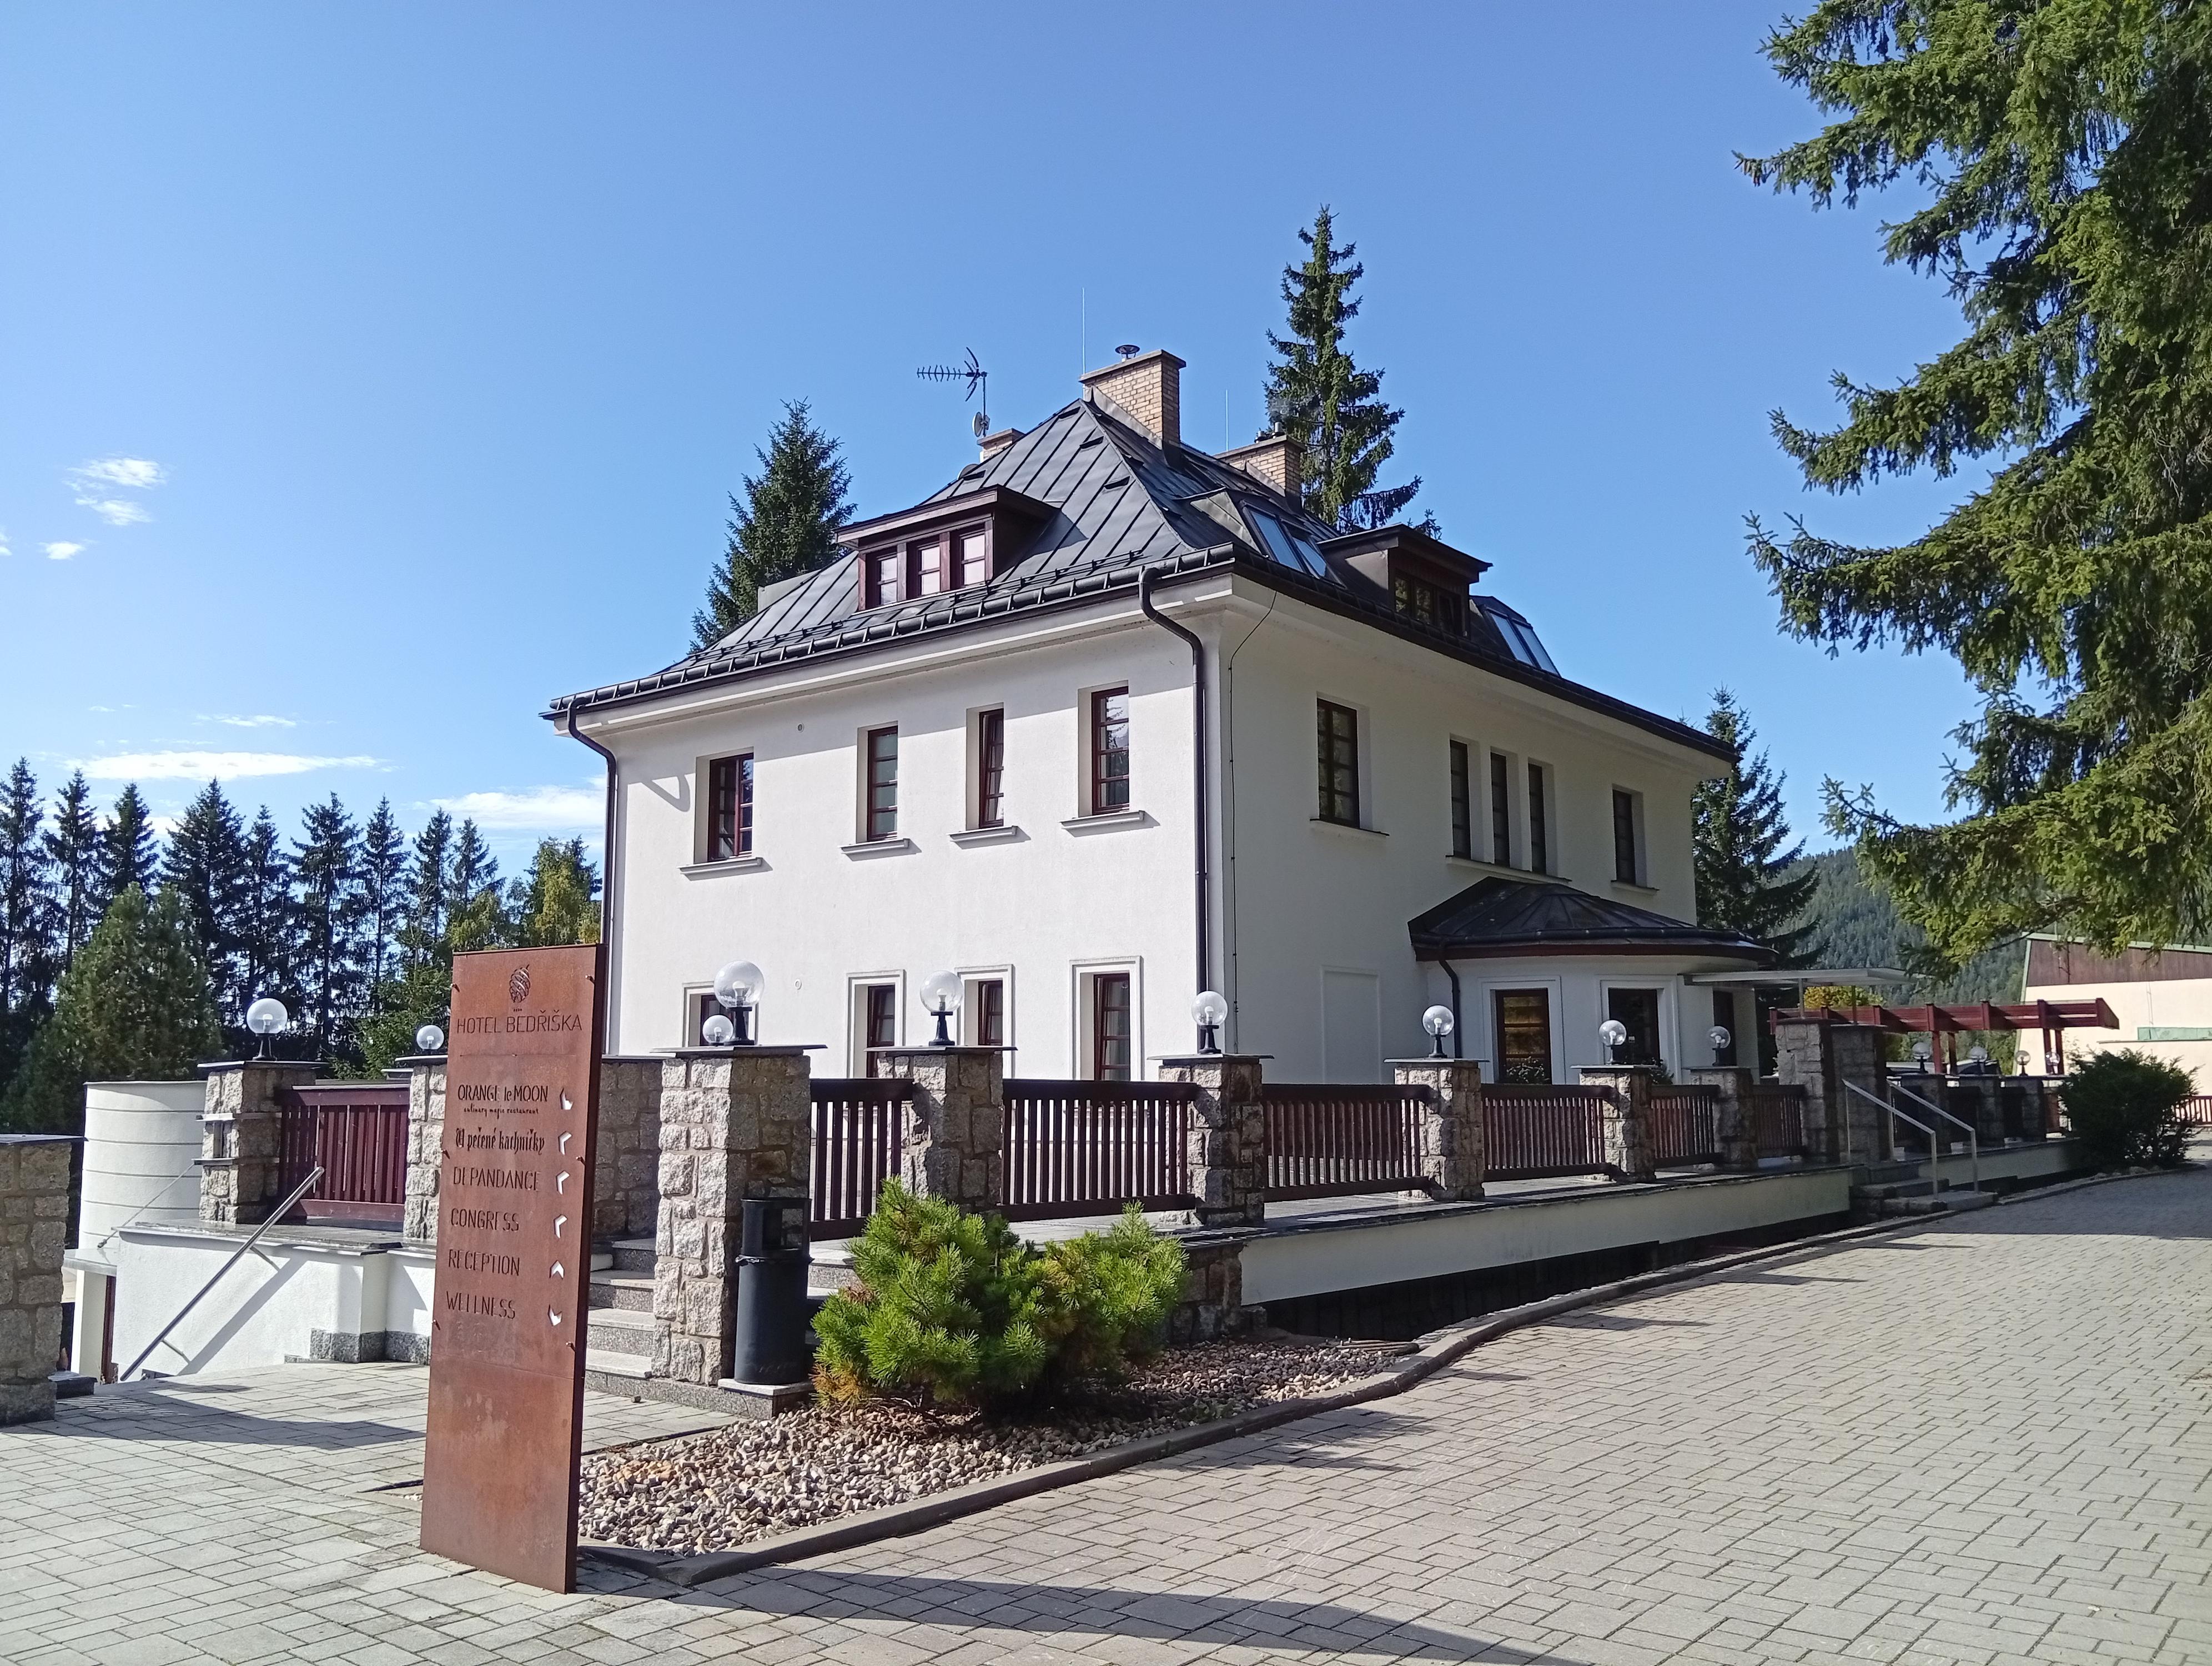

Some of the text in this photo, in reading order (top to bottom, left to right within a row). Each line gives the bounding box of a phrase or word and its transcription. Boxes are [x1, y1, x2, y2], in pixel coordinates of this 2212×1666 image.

[456, 1009, 583, 1034] HOTEL BEDŘIŠKA
[458, 1084, 500, 1102] ORANGE
[464, 1103, 487, 1117] culinary
[489, 1105, 505, 1120] magic
[467, 1126, 496, 1152] pečené
[499, 1128, 545, 1156] kachničky
[453, 1166, 542, 1192] DEPANDANCE
[450, 1207, 520, 1232] CONGRESS
[448, 1248, 520, 1277] RECEPTION
[446, 1290, 516, 1320] WELLNESS
